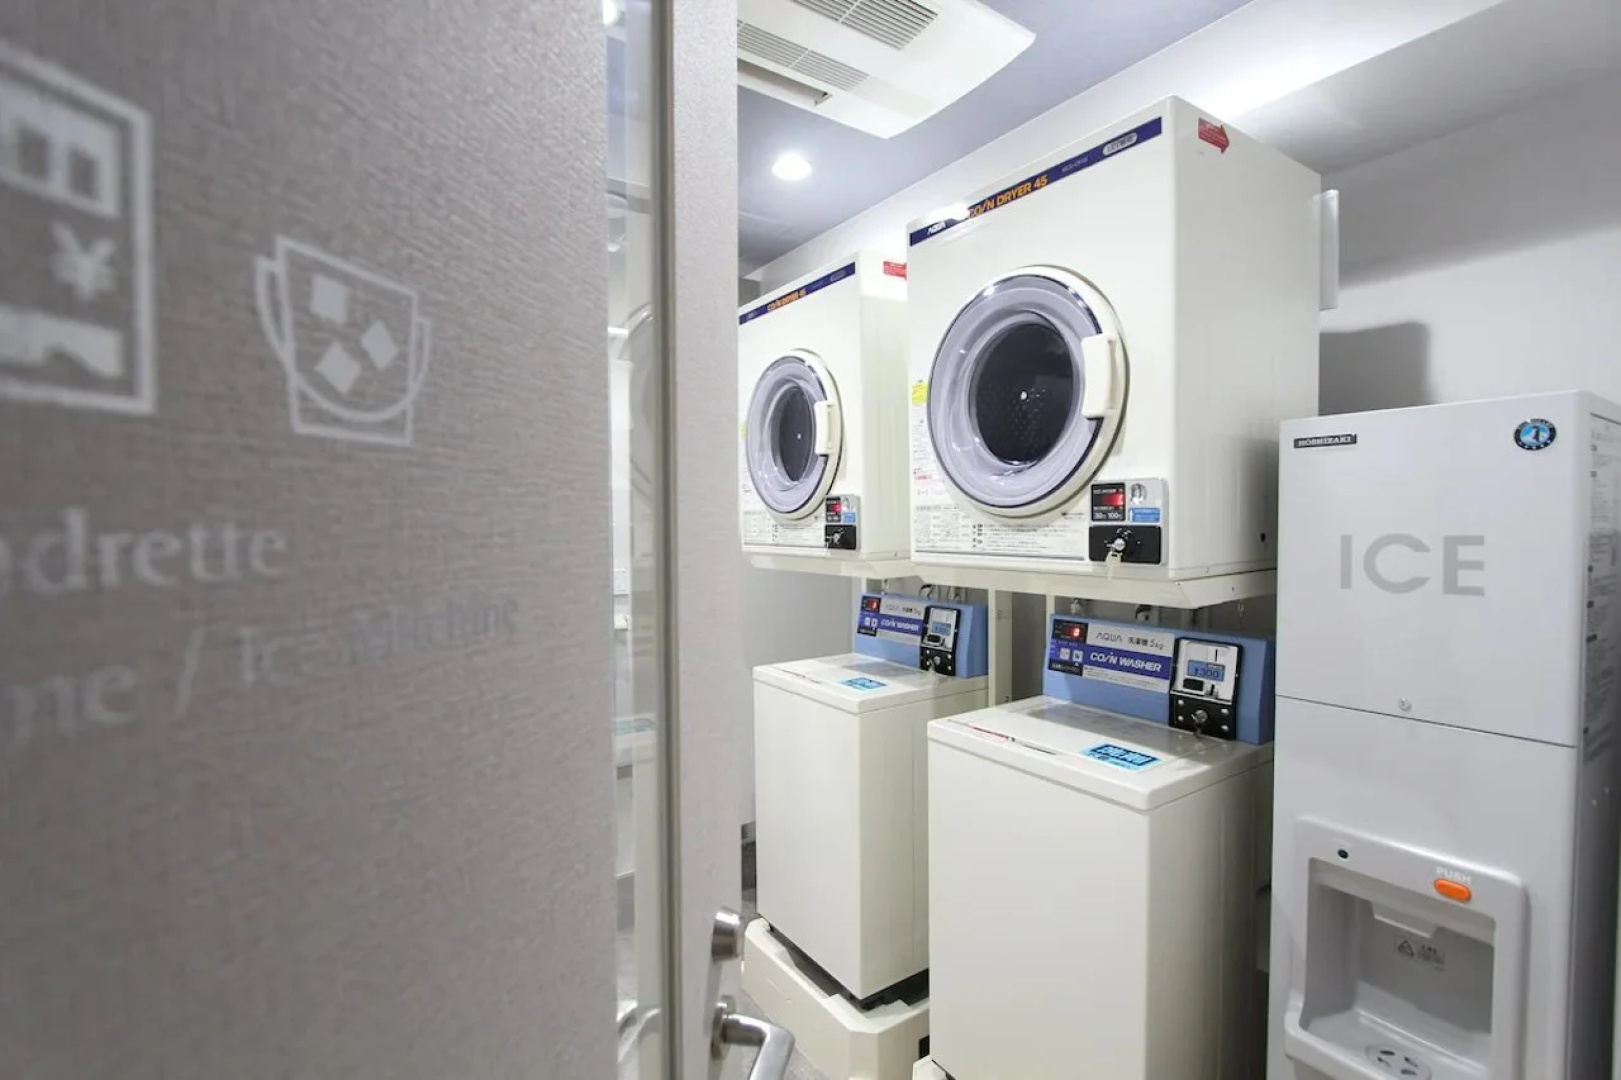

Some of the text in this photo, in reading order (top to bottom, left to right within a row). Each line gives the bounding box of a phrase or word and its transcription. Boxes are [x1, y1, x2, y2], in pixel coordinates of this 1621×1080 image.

[996, 181, 1032, 206] DRYER
[1033, 174, 1049, 190] 45
[1340, 533, 1485, 596] ICE
[1096, 632, 1123, 644] AQUA
[1119, 658, 1162, 672] WASHER
[1436, 866, 1472, 883] PUSH
